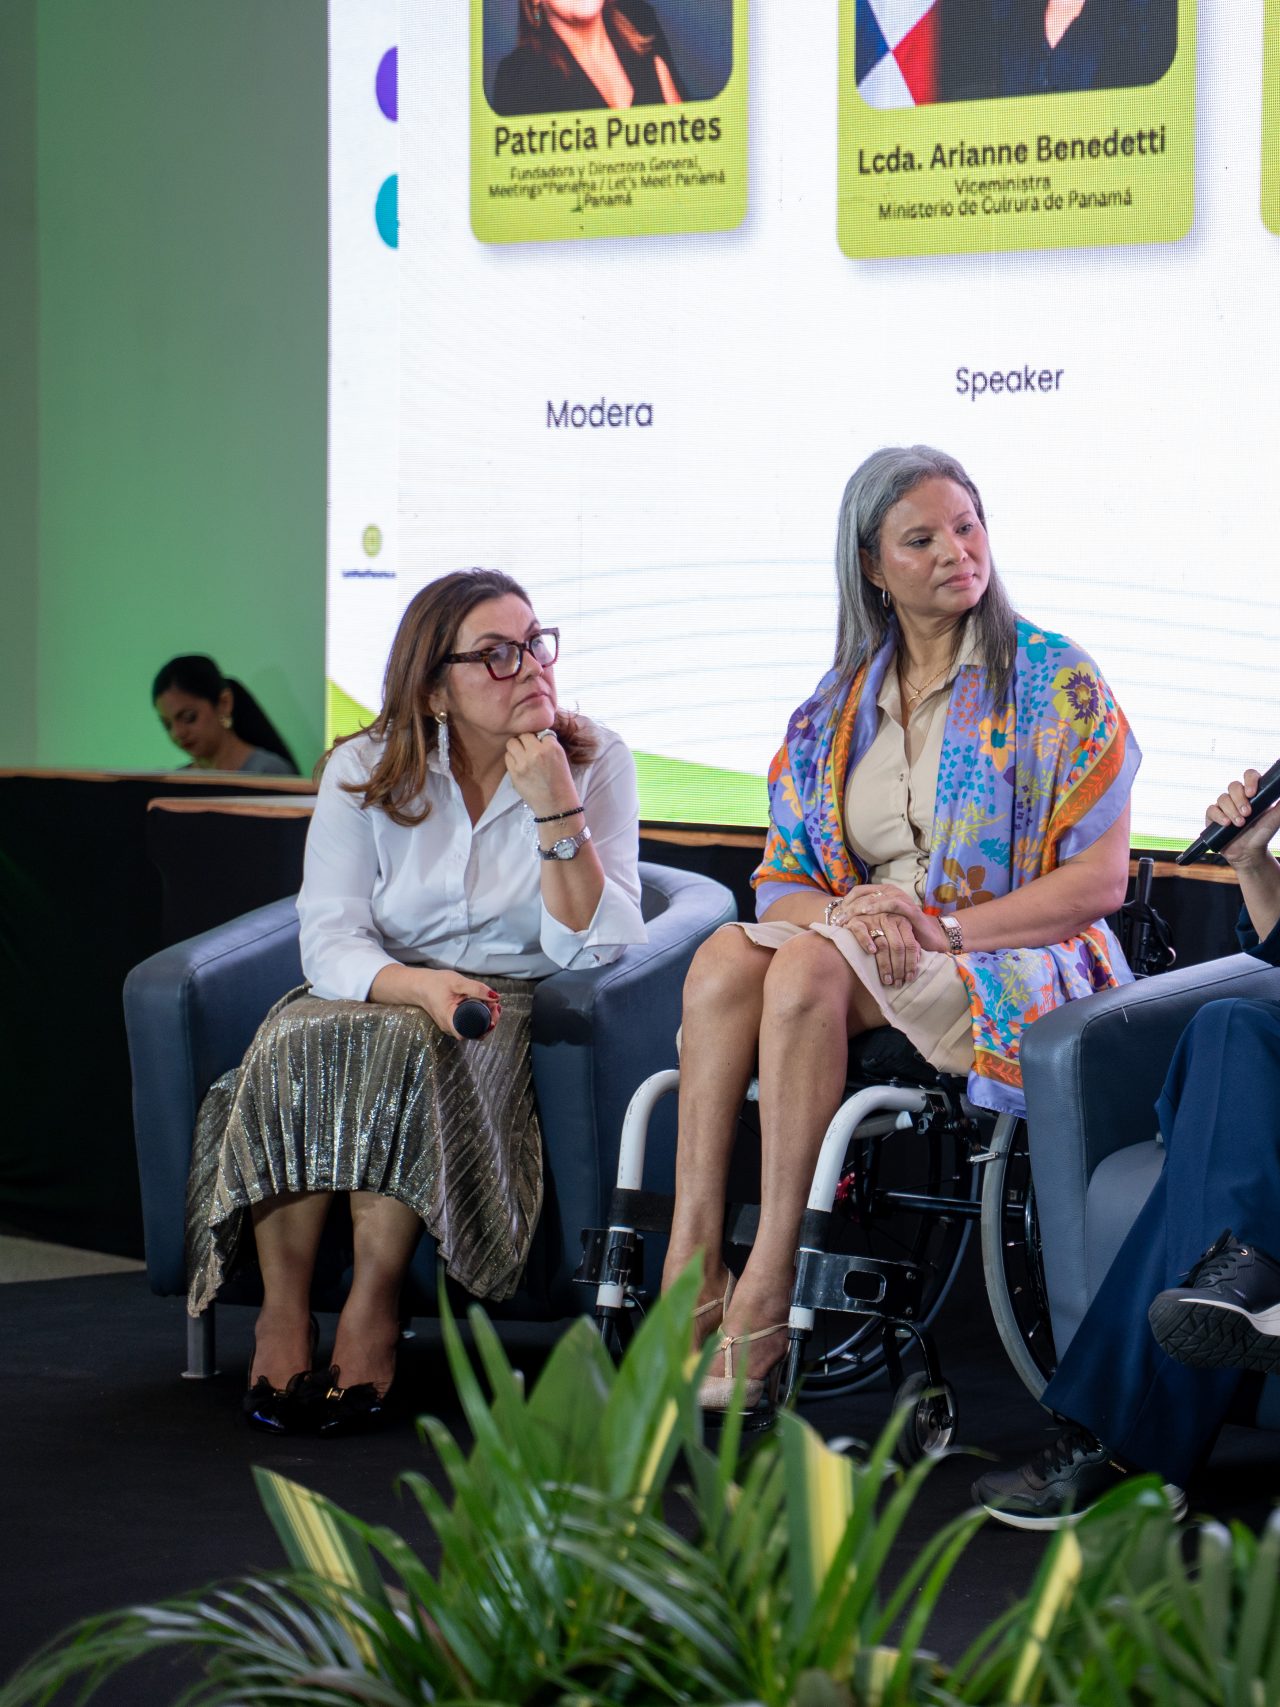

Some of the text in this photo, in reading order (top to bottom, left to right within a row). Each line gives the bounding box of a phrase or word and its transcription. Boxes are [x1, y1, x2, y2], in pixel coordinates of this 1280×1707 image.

[494, 114, 722, 157] Patricia Puentes
[857, 125, 1166, 176] Lcda. Arianne Benedetti
[589, 160, 645, 176] Directora
[641, 173, 671, 188] Meet
[954, 174, 1052, 196] Viceministra
[878, 200, 954, 221] Ministerio
[958, 198, 978, 216] de
[1044, 192, 1064, 211] de
[1068, 187, 1133, 209] Panamá
[955, 363, 1064, 402] Speaker
[546, 397, 655, 429] Modera
